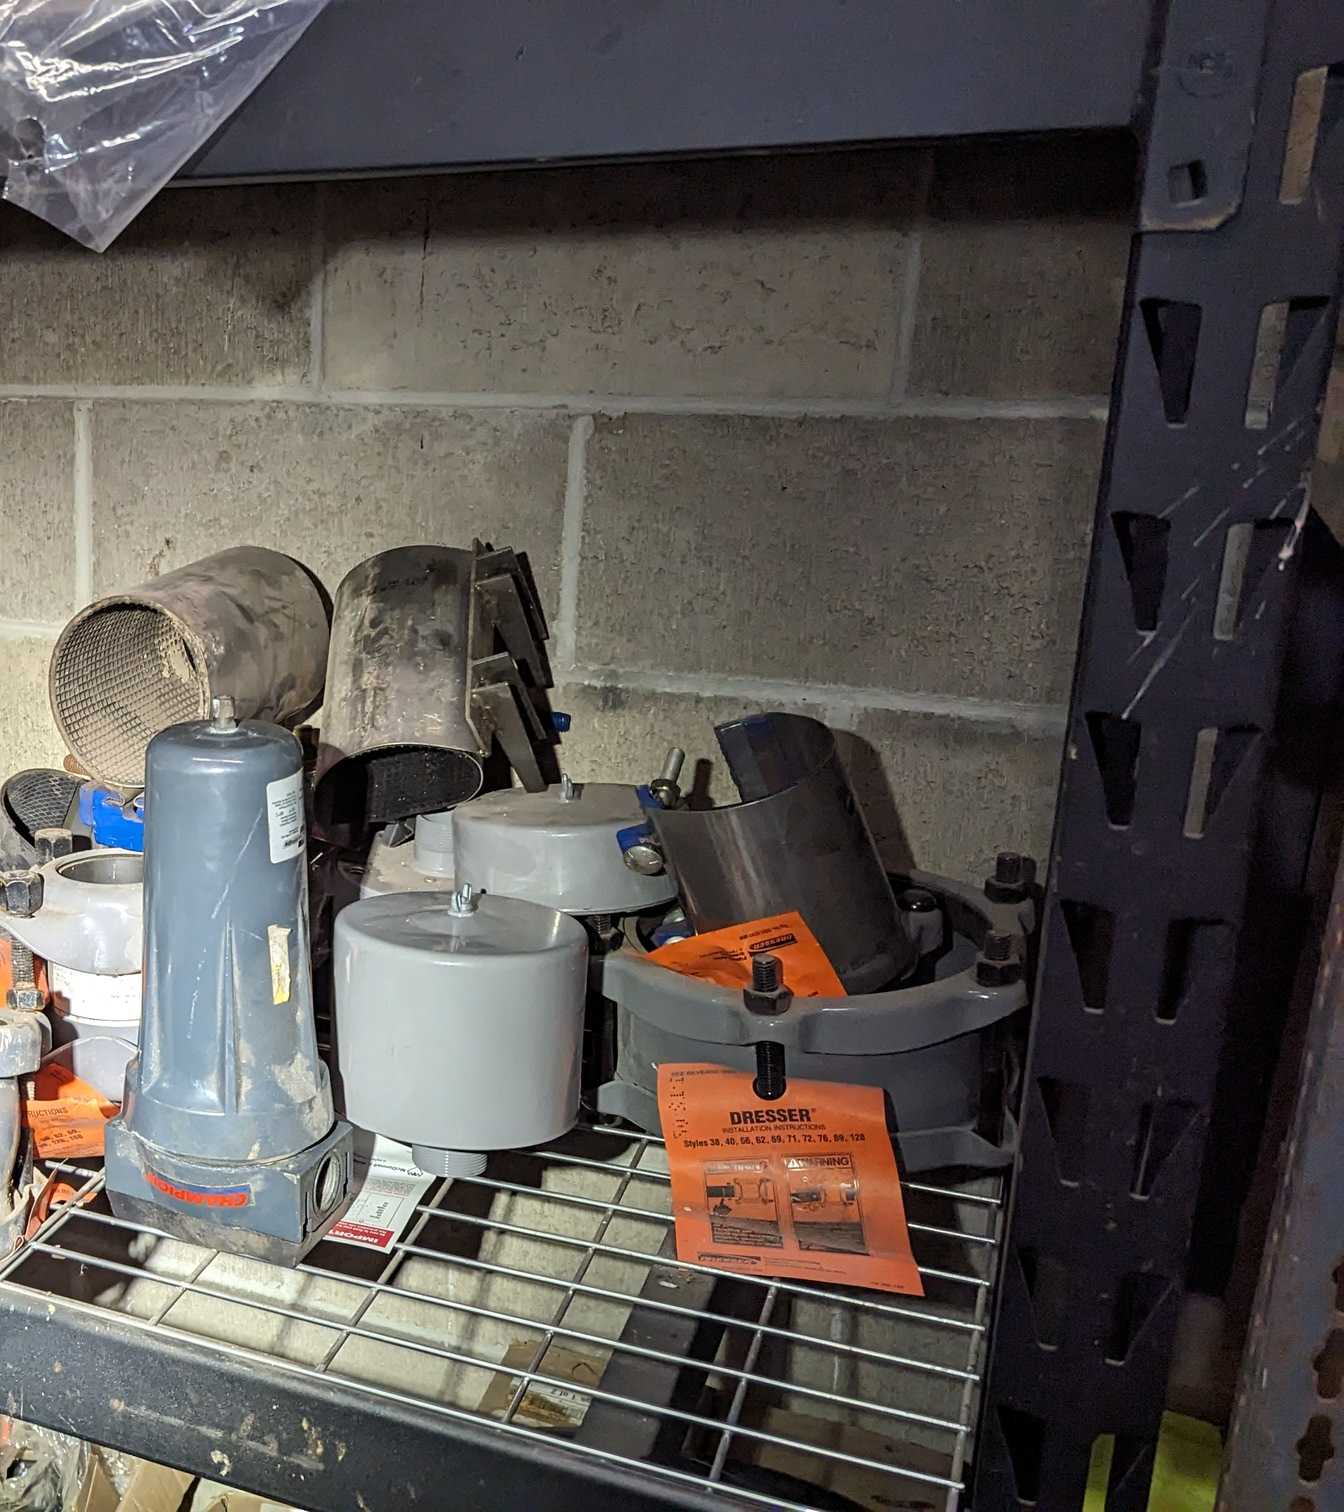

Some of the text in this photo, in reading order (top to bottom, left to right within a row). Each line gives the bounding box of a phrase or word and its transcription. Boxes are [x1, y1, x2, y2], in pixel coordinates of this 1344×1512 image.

[729, 1108, 812, 1126] DRESSER
[722, 1123, 826, 1134] INSTALLATION INSTRUCTIONS
[683, 1138, 709, 1149] Styles
